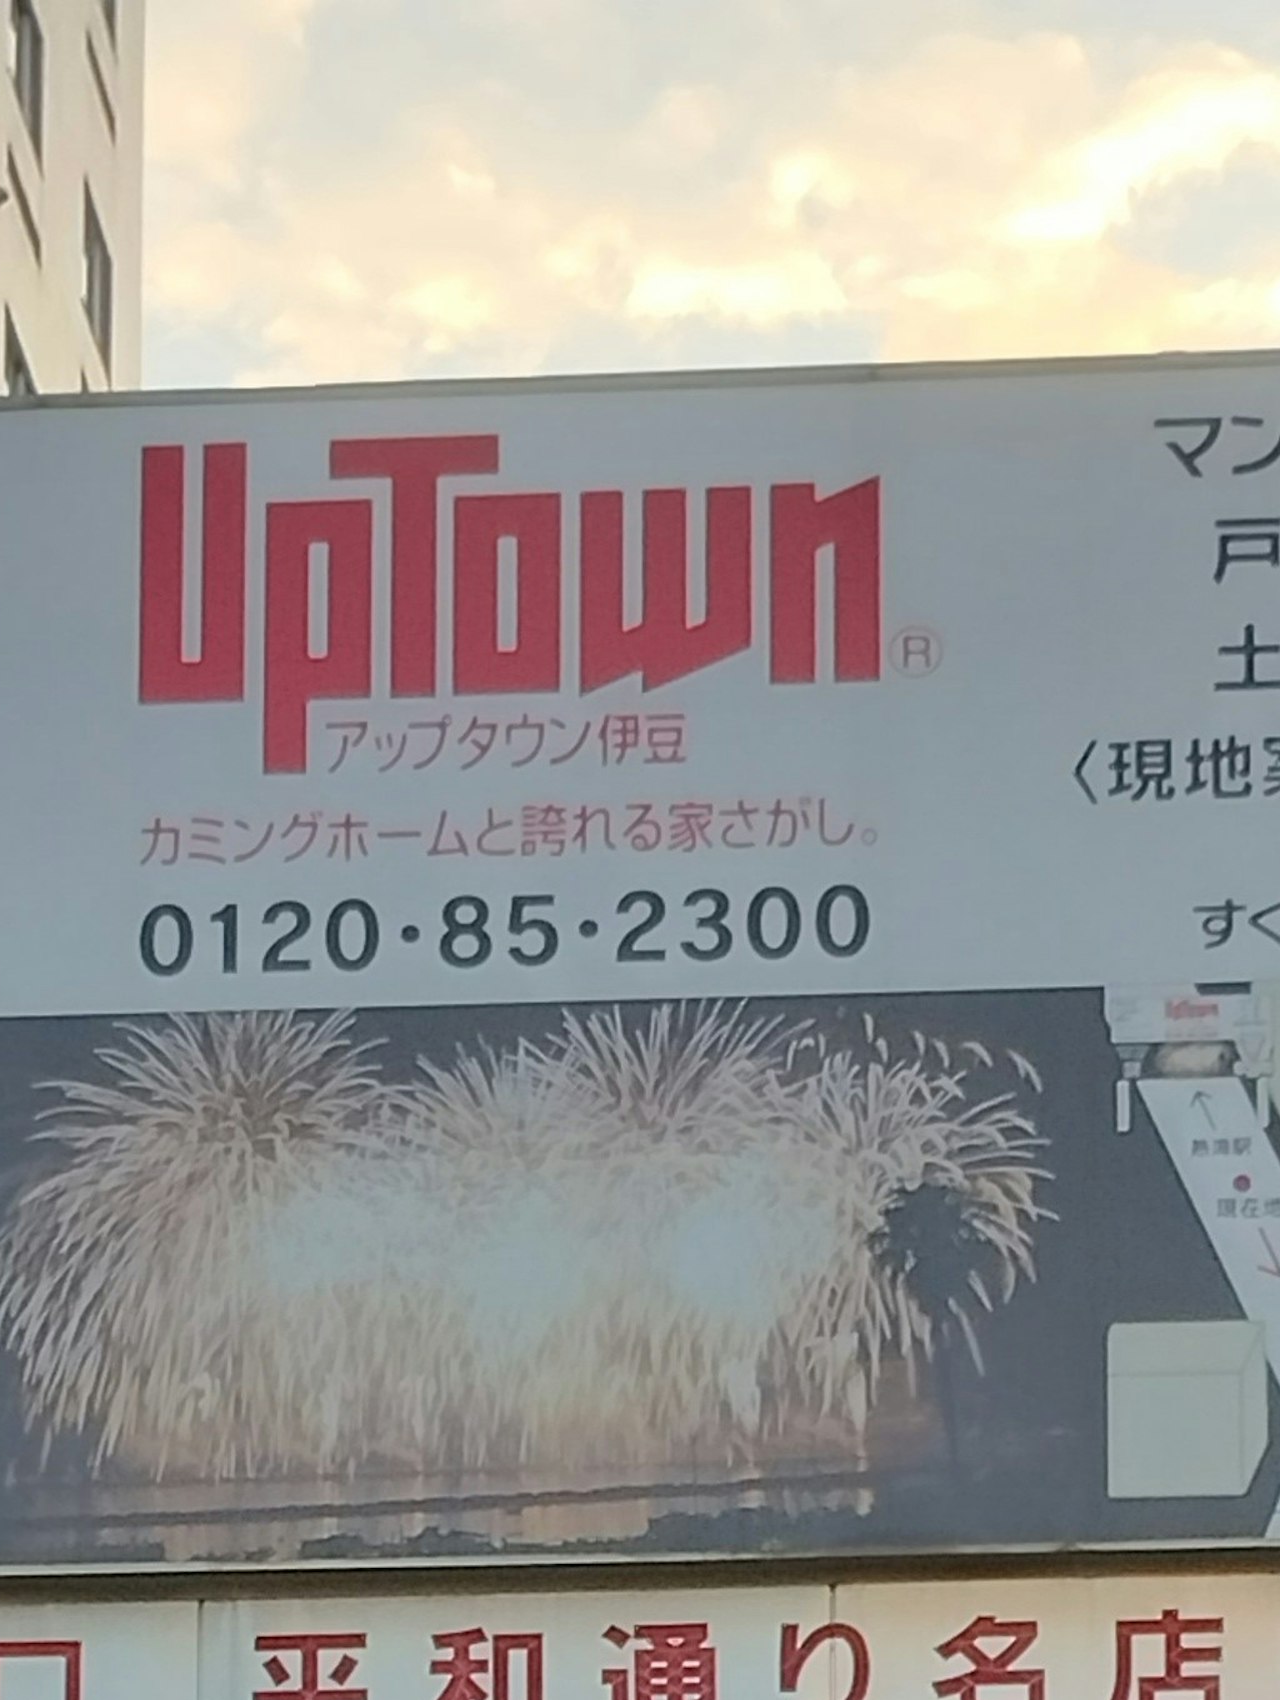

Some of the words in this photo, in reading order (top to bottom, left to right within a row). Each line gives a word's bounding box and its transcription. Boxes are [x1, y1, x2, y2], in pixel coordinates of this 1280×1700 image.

[138, 434, 881, 775] UpTown
[326, 713, 687, 773] アップタウン伊豆
[140, 798, 879, 867] カミングホームと誇れる家さがし。
